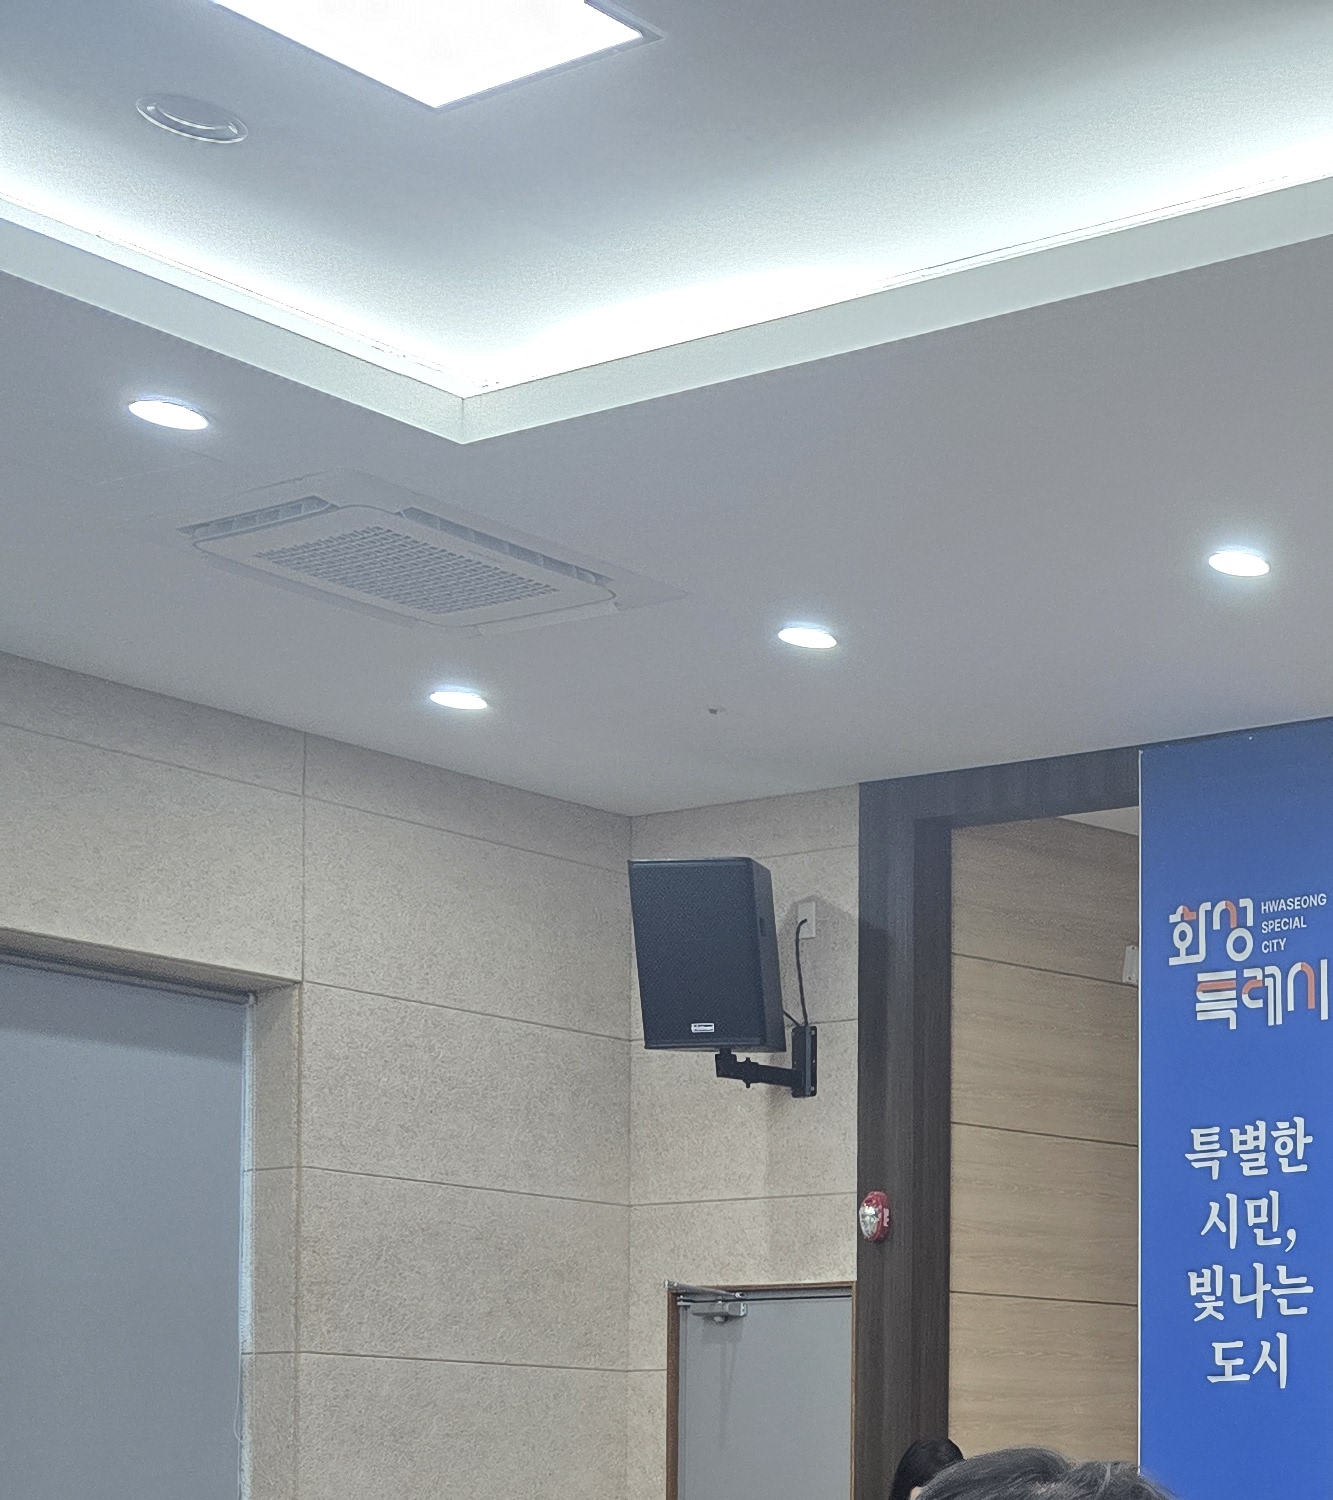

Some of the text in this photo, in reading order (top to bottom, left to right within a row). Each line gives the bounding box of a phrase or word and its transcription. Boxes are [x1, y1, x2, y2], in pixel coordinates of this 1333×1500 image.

[1169, 898, 1253, 966] 화성
[1261, 893, 1327, 914] HWASEONG
[1261, 916, 1307, 934] SPECIAL
[1261, 937, 1287, 954] CITY
[1196, 958, 1329, 1030] 특례시
[1184, 1116, 1313, 1181] 특별한
[1200, 1189, 1297, 1253] 시민,
[1187, 1262, 1314, 1322] 빛나는
[1206, 1331, 1288, 1389] 도시
